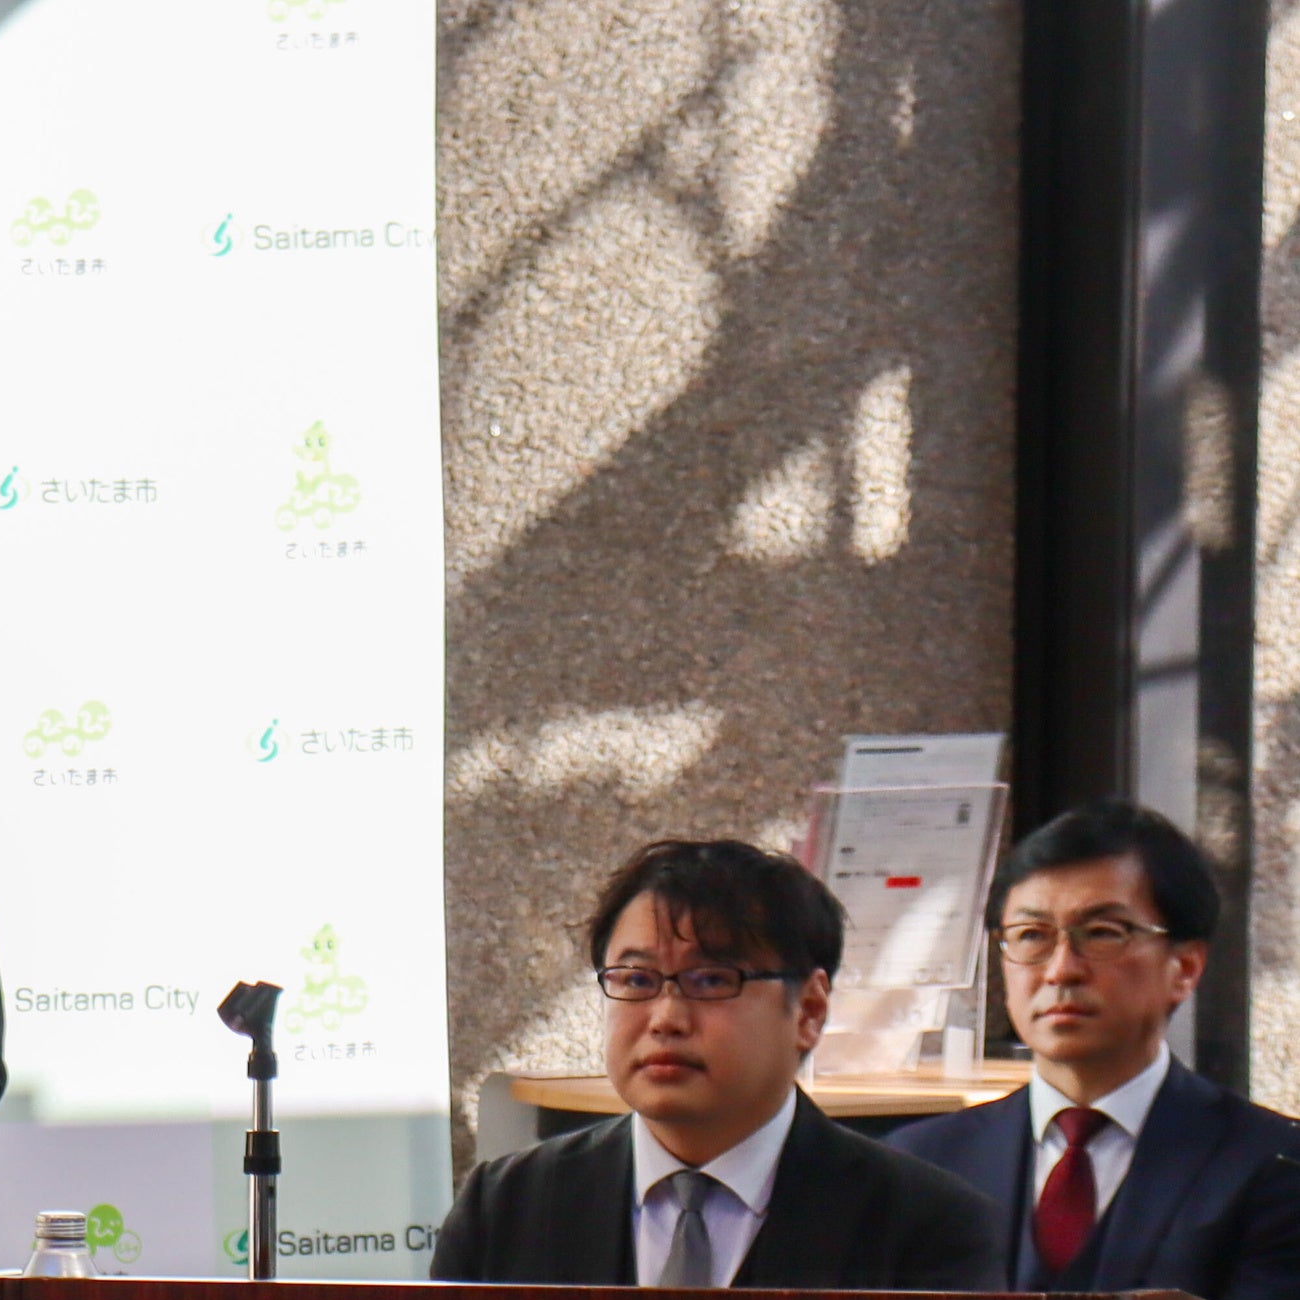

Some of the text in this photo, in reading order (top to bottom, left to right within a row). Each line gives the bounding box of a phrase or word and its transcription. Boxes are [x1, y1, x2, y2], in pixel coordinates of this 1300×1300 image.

[254, 221, 374, 251] Saitama
[20, 258, 108, 275] さいたま市
[40, 477, 158, 505] さいたま市
[300, 726, 414, 755] さいたま市
[32, 769, 118, 786] さいたま市
[14, 985, 199, 1015] Saitama City
[278, 1229, 396, 1256] Saitama
